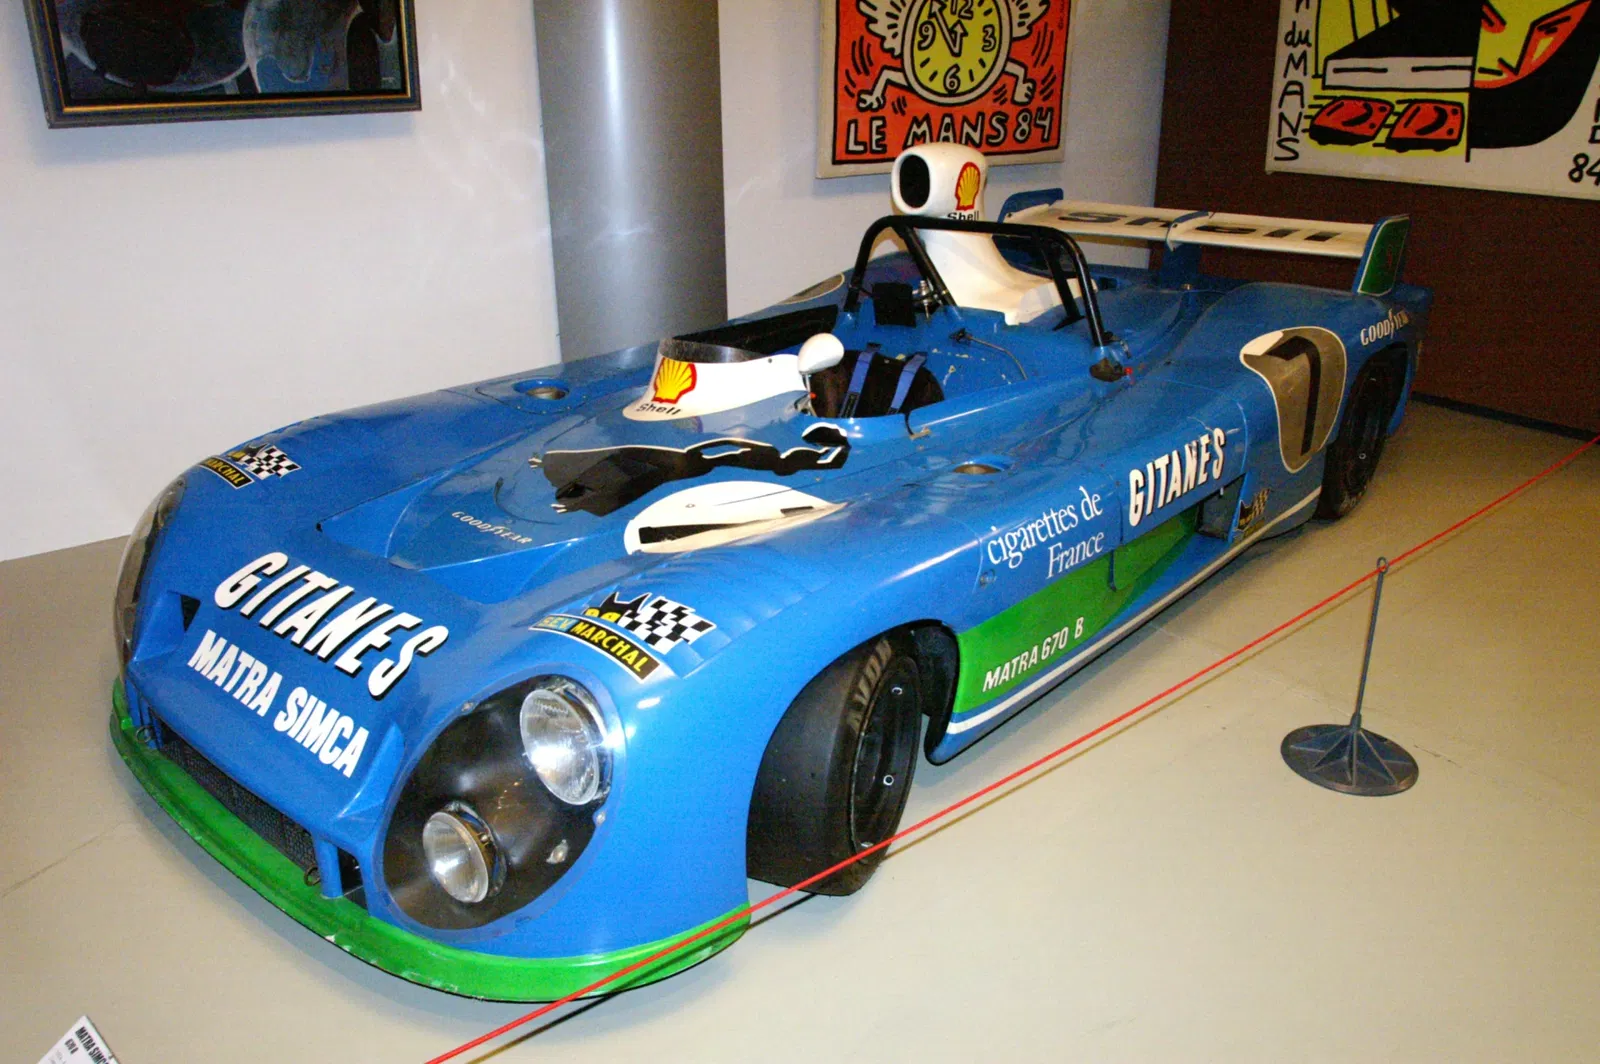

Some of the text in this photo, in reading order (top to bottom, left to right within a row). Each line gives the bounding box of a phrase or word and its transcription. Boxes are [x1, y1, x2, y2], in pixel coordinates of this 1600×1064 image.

[950, 0, 974, 20] 12
[917, 20, 936, 51] 9
[981, 24, 996, 52] 3
[1284, 20, 1312, 48] du
[943, 63, 961, 94] 6
[845, 106, 1054, 154] LE MANS 84
[947, 210, 980, 220] Shell
[636, 402, 682, 416] Shell
[1129, 427, 1226, 526] GITANES
[987, 485, 1104, 569] cigarettes de
[1046, 531, 1105, 579] France
[214, 552, 449, 700] GITANES
[570, 621, 649, 673] MARCHAL
[982, 616, 1085, 692] MATRA 670 B
[187, 629, 370, 778] MATRA SIMCA
[75, 1026, 109, 1064] MATRA SIMC
